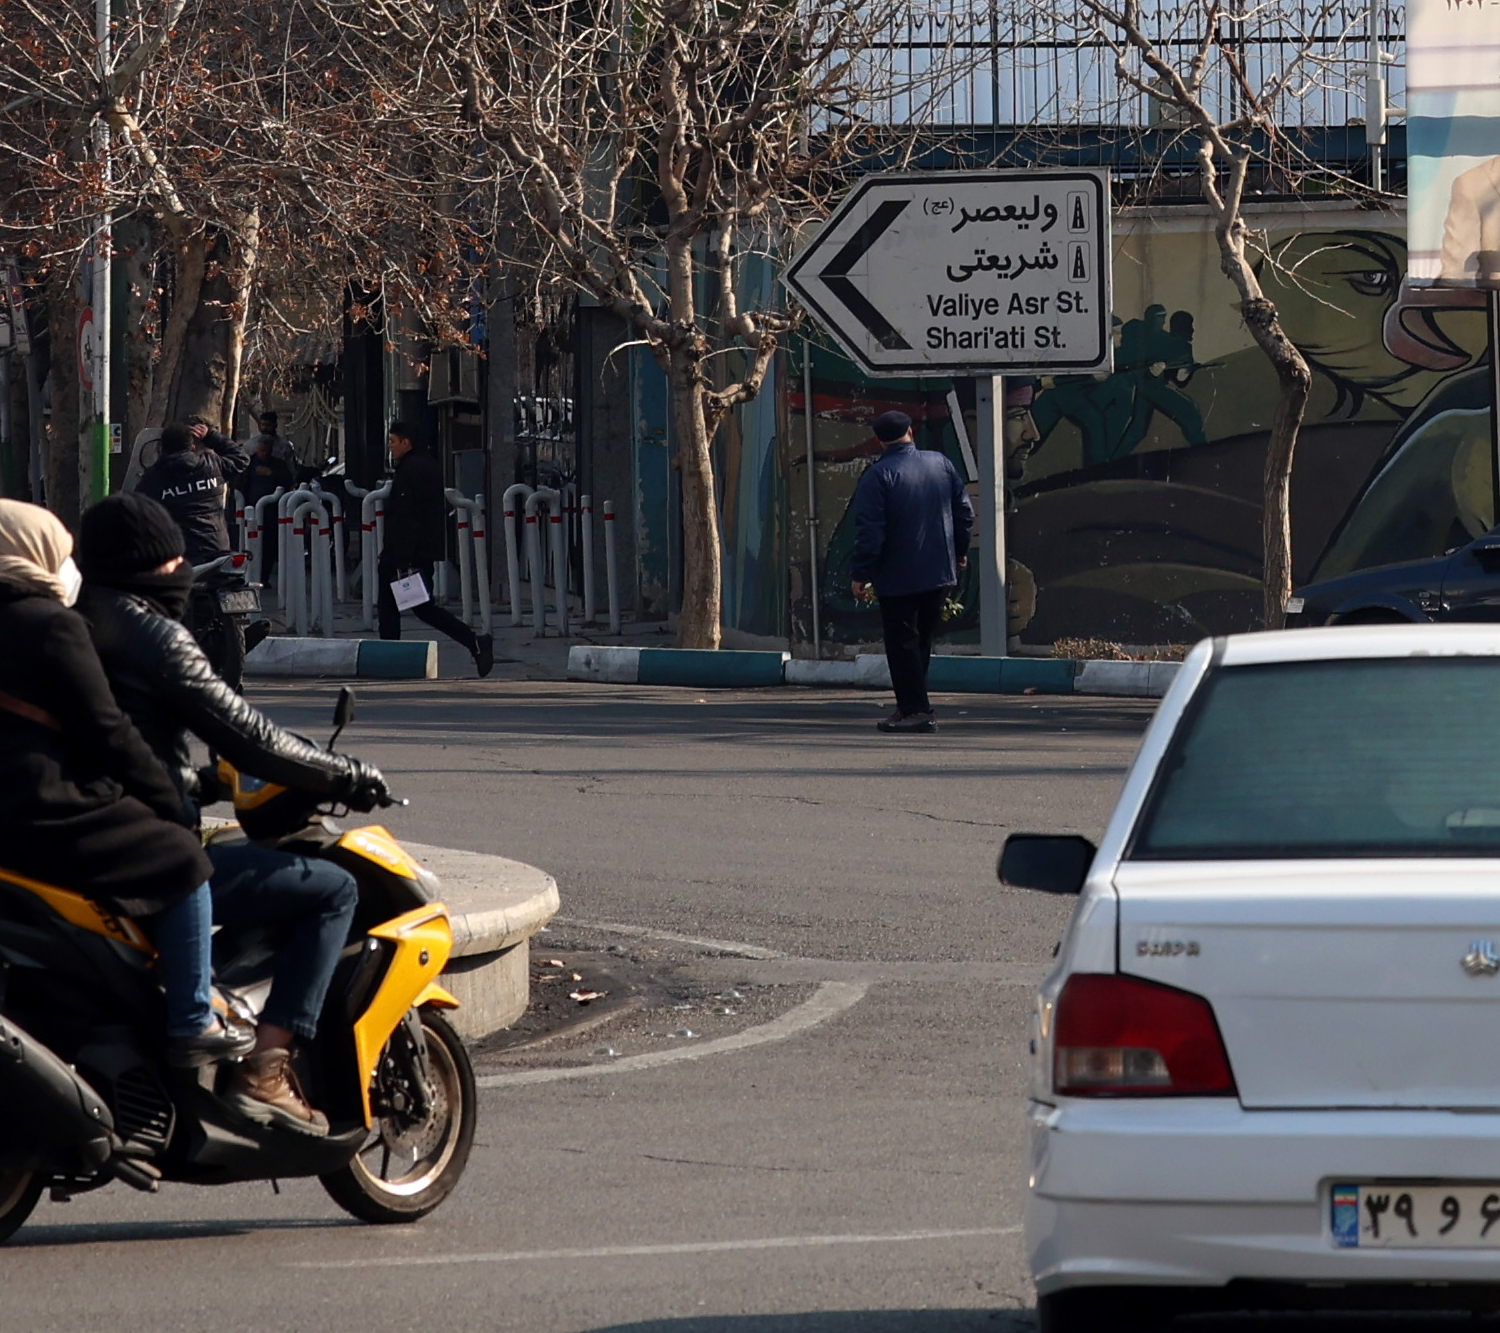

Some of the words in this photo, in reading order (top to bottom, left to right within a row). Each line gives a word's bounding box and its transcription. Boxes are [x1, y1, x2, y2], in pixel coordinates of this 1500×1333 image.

[951, 194, 1059, 233] ولیعصر
[946, 240, 1059, 283] شریعتی
[926, 293, 1000, 320] Valiye
[1007, 291, 1050, 315] Asr
[1056, 290, 1089, 314] St.
[926, 326, 1026, 349] Shari'ati
[1034, 325, 1067, 349] St.
